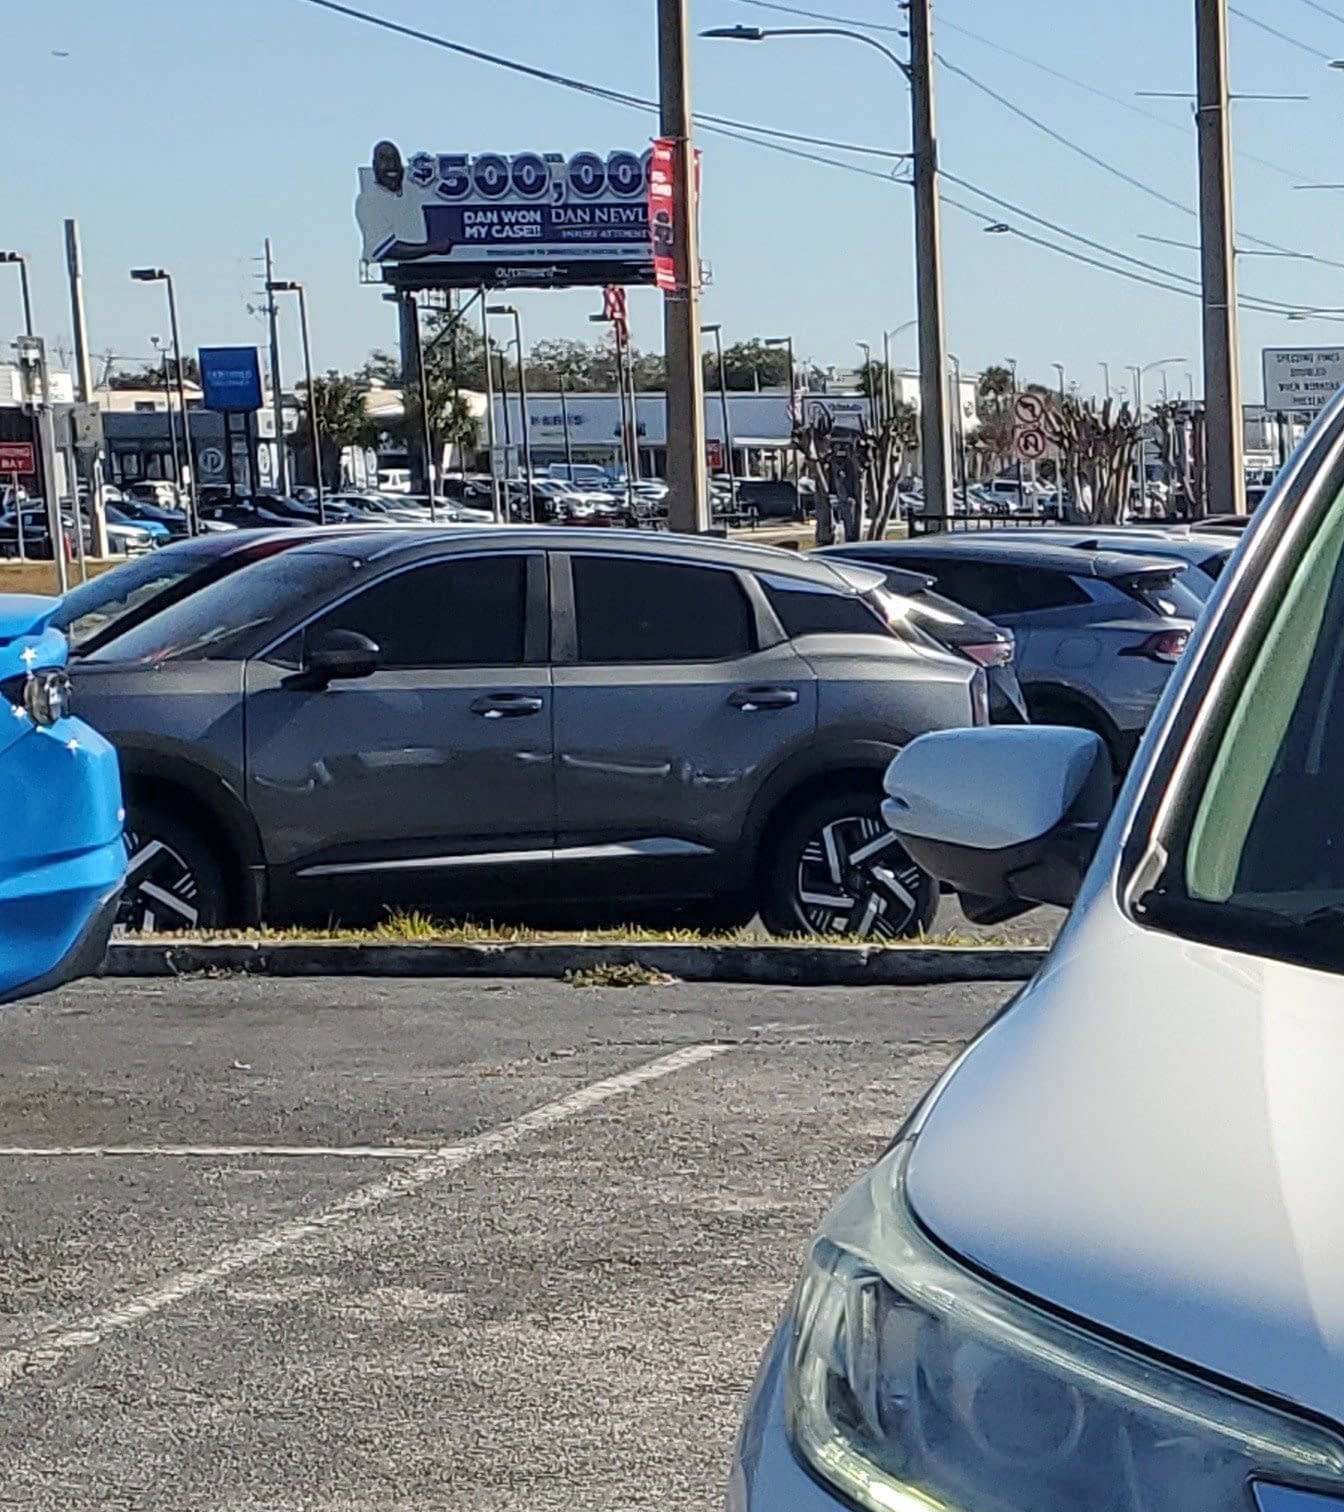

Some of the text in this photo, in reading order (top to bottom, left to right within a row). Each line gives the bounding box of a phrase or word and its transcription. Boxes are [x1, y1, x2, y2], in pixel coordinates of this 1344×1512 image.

[411, 151, 655, 206] $500,00
[464, 210, 542, 224] DAN WON
[551, 207, 649, 223] DAN NEWL
[464, 225, 542, 238] MY CASE!!
